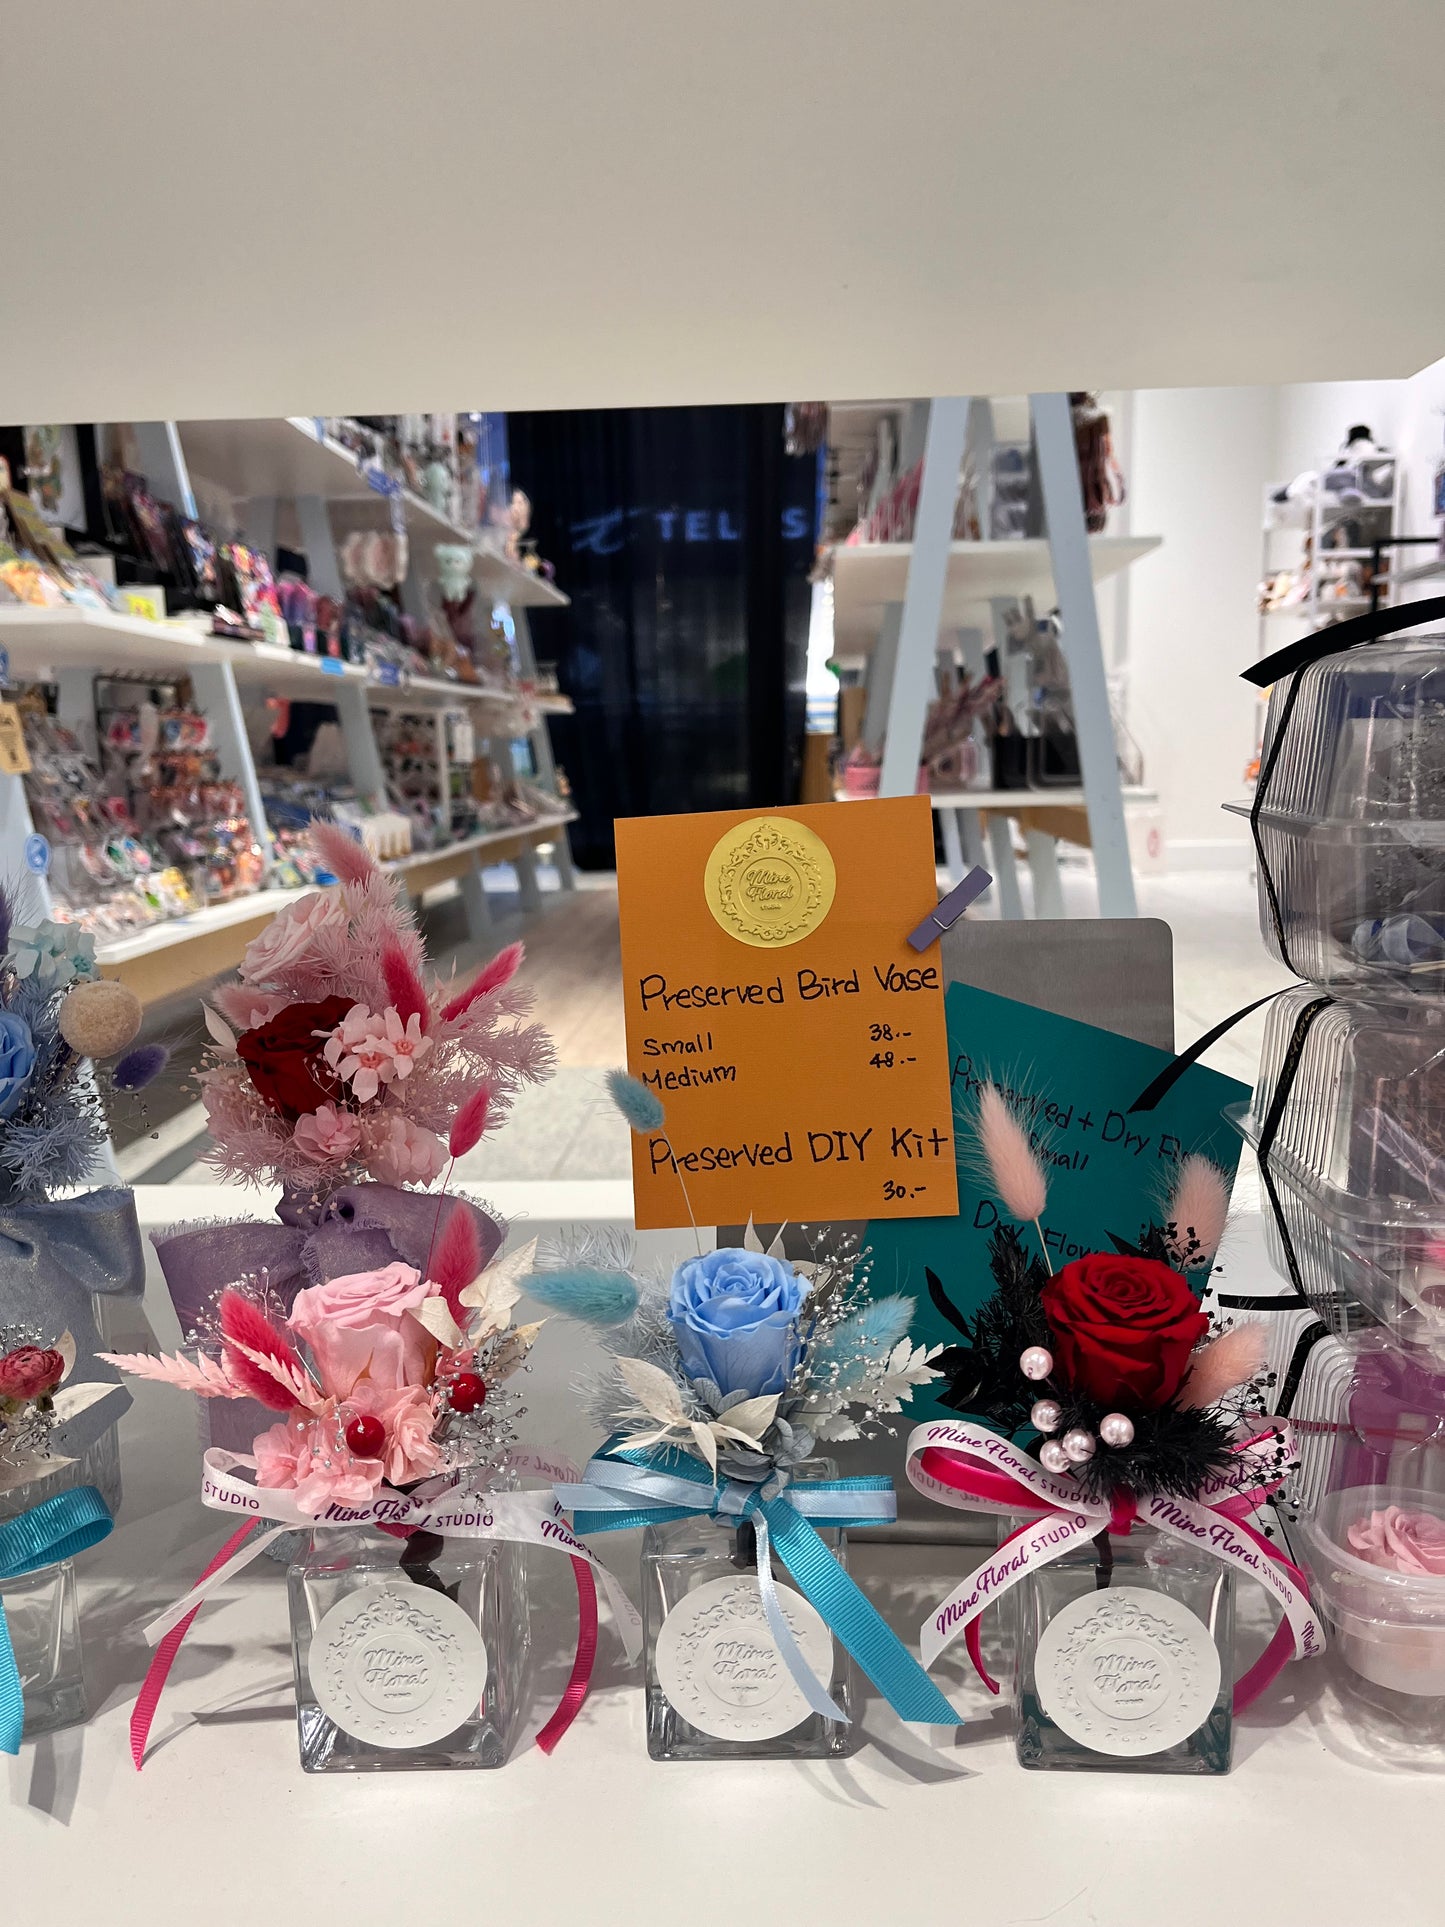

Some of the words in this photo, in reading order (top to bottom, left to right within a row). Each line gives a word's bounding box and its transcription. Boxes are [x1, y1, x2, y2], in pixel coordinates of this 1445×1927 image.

[746, 869, 792, 886] Mine
[746, 885, 794, 902] Floral
[639, 974, 785, 1011] Preserved
[797, 968, 860, 1000] Bird
[873, 963, 940, 993] Vase
[642, 1031, 713, 1056] Small
[642, 1064, 736, 1090] Medium
[1078, 1111, 1094, 1131] +
[1101, 1109, 1150, 1156] Dry
[649, 1131, 793, 1174] Preserved
[807, 1127, 873, 1163] DIY
[890, 1127, 949, 1158] Kit
[927, 1426, 982, 1448] Mine
[985, 1438, 1037, 1482] Floral
[1041, 1479, 1101, 1506] STUDIO
[203, 1480, 260, 1510] STUDIO
[435, 1512, 494, 1528] STUDIO
[541, 1520, 584, 1550] Mine
[1151, 1497, 1207, 1538] Mine
[1209, 1524, 1260, 1570] Floral
[1262, 1562, 1293, 1605] STUDIO
[936, 1591, 980, 1636] Mine
[976, 1545, 1030, 1595] Floral
[1031, 1515, 1088, 1553] STUDIO
[364, 1648, 424, 1667] Mine
[714, 1641, 774, 1660] Mine
[1093, 1654, 1157, 1672] Mine
[364, 1668, 428, 1688] Floral
[713, 1660, 777, 1681] Floral
[1093, 1673, 1161, 1694] Floral
